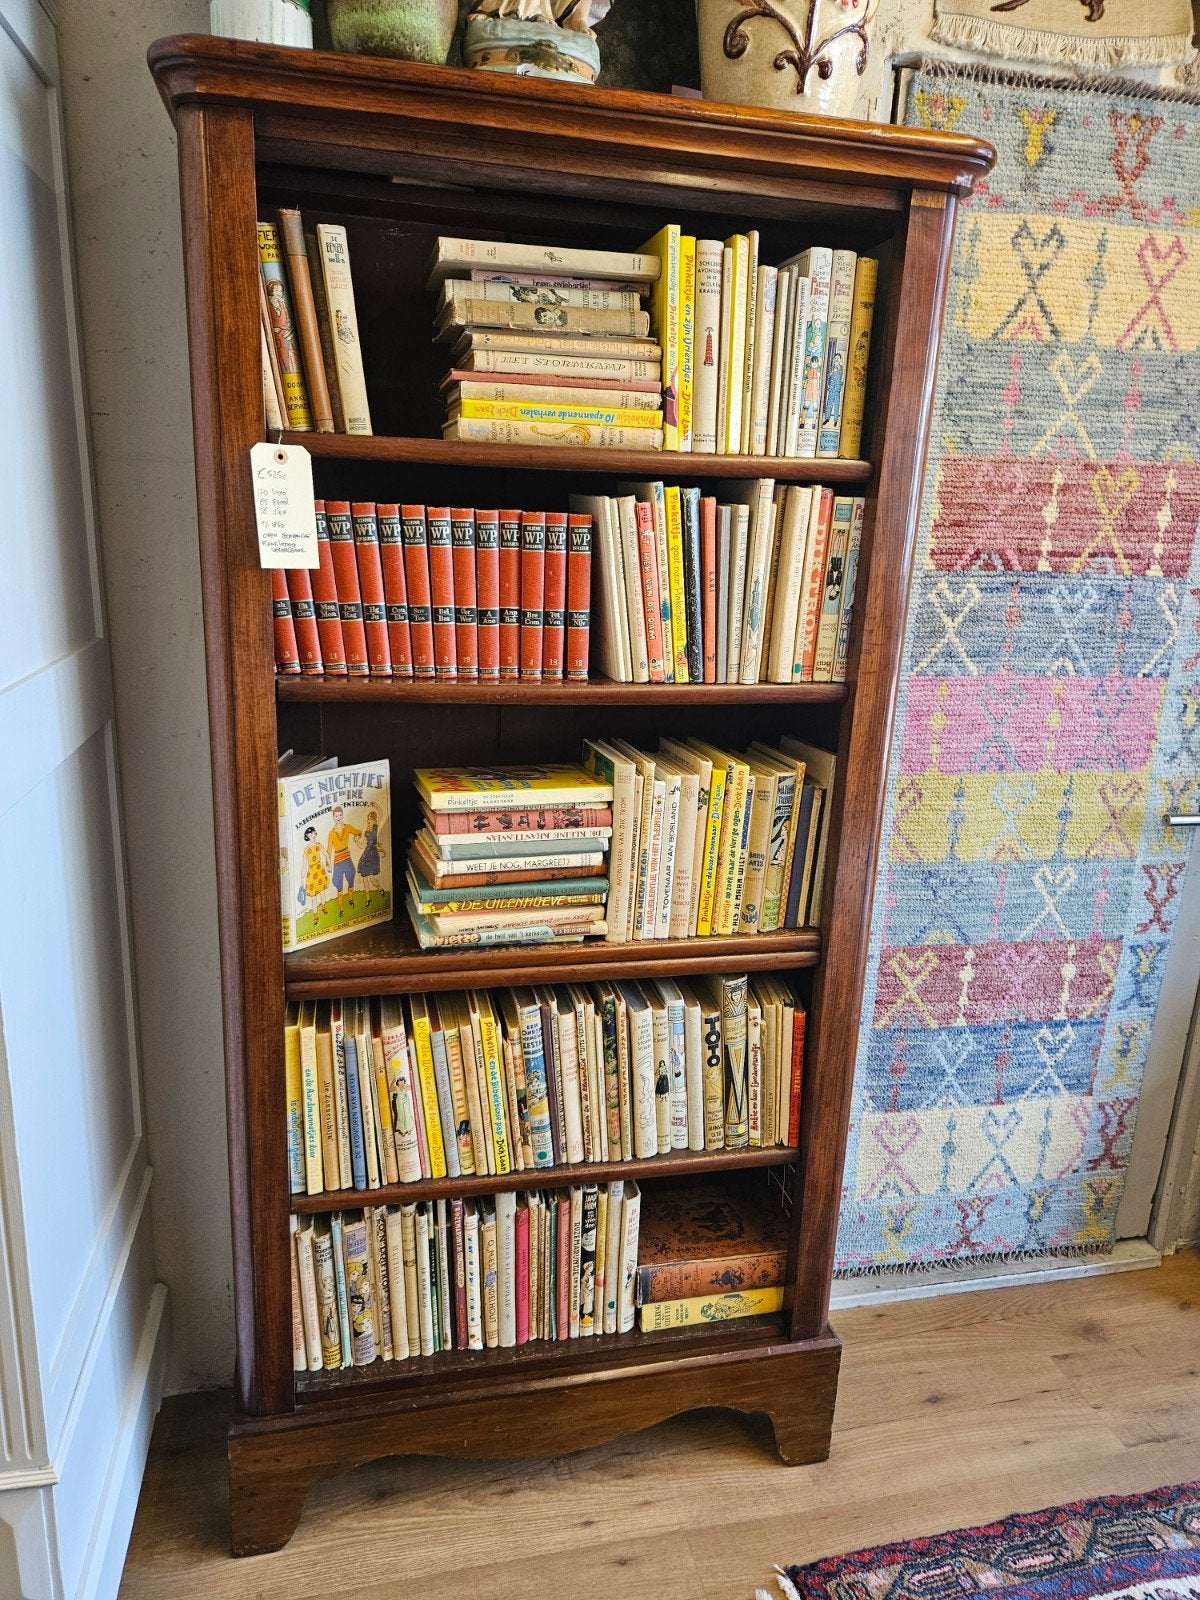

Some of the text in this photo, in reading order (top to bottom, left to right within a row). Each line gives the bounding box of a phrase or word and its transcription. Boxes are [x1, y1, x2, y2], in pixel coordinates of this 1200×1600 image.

[669, 304, 678, 348] Pinkeltje
[681, 254, 694, 442] Pinkeltje en zijn Vriendjes Dick Laan
[532, 356, 626, 372] STORMKAMP
[494, 405, 519, 417] Dick
[519, 407, 557, 419] verhalen
[557, 409, 604, 422] spannende
[604, 414, 615, 423] 10
[617, 413, 656, 425] Pinkeltje
[670, 493, 680, 540] Pinkeltje
[329, 520, 351, 535] WP
[355, 522, 377, 536] WP
[381, 522, 402, 537] WP
[403, 524, 424, 538] WP
[431, 527, 450, 539] WP
[454, 528, 473, 540] WP
[479, 530, 498, 542] WP
[525, 532, 544, 544] WP
[548, 532, 566, 544] WP
[572, 533, 590, 545] WP
[671, 545, 680, 566] gaat
[643, 551, 656, 641] HEK VAN DE DAM
[734, 564, 744, 625] MARJOLEINTJE
[677, 644, 687, 664] Dick
[677, 662, 688, 680] Laan
[734, 770, 744, 790] Laan
[293, 773, 385, 807] DE NICHTJES
[318, 789, 364, 808] JET INE
[447, 798, 478, 806] Pinkeltje
[711, 801, 720, 820] Dick
[668, 801, 678, 843] BOSLAND
[486, 829, 601, 842] DE KLEINE KRANTENMAN
[650, 807, 663, 872] VAN HET PLEINTJE
[708, 824, 717, 854] tovenaar
[727, 850, 735, 859] de
[466, 858, 570, 872] WEET JE NOG, MARGREET?
[617, 849, 625, 887] AVONTUREN
[706, 856, 714, 871] boze
[727, 859, 735, 876] naar
[705, 871, 712, 880] de
[635, 848, 647, 930] EEN NIEUW BEGIN
[662, 864, 672, 911] TOVENAAR
[706, 880, 711, 889] en
[725, 876, 733, 891] zoek
[733, 902, 740, 911] JE
[737, 856, 745, 876] WILT
[724, 891, 731, 899] op
[461, 896, 565, 911] DE UILENHOEVE
[701, 889, 710, 923] Pinkeltje
[661, 912, 668, 924] DE
[720, 900, 731, 929] Pinkeltje
[485, 1021, 496, 1060] Pinkeltje
[704, 1016, 721, 1068] TOTO
[305, 1068, 312, 1077] en
[489, 1060, 496, 1070] en
[306, 1078, 314, 1087] de
[490, 1071, 498, 1080] de
[750, 1088, 758, 1101] haar
[350, 1096, 358, 1110] VAN
[306, 1088, 317, 1143] Aardmannetjes
[750, 1110, 758, 1131] Ankie
[352, 1111, 360, 1149] AVONTUREN
[495, 1122, 503, 1135] pap
[431, 1132, 440, 1146] door
[497, 1139, 506, 1154] Dick
[354, 1151, 361, 1159] DE
[432, 1146, 442, 1161] Dick
[433, 1161, 443, 1177] Laan
[499, 1155, 507, 1172] Laan
[573, 1222, 581, 1277] ROZEMARIJNTJE
